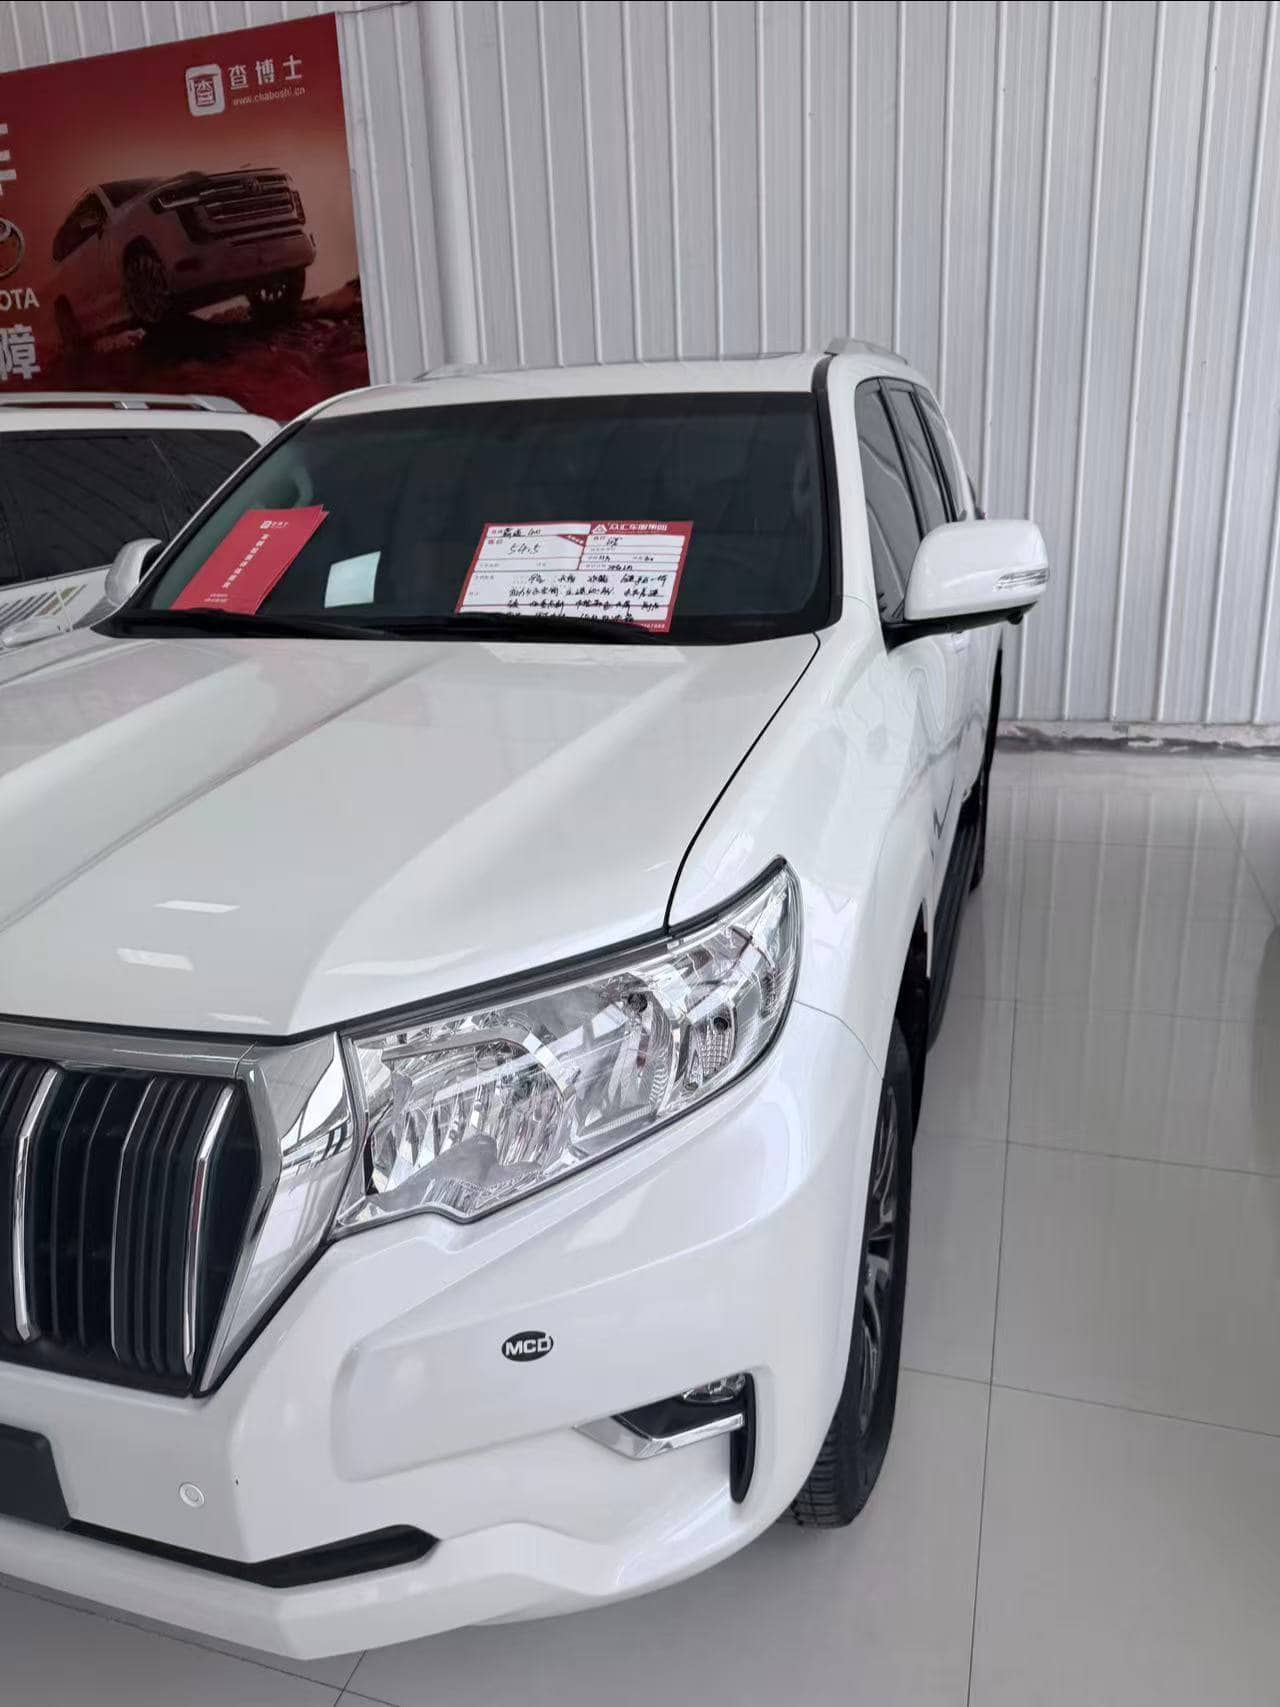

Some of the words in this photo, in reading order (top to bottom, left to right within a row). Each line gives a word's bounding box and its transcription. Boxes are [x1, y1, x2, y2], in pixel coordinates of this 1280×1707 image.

[228, 55, 302, 90] 查博士
[505, 1334, 552, 1356] MCD
